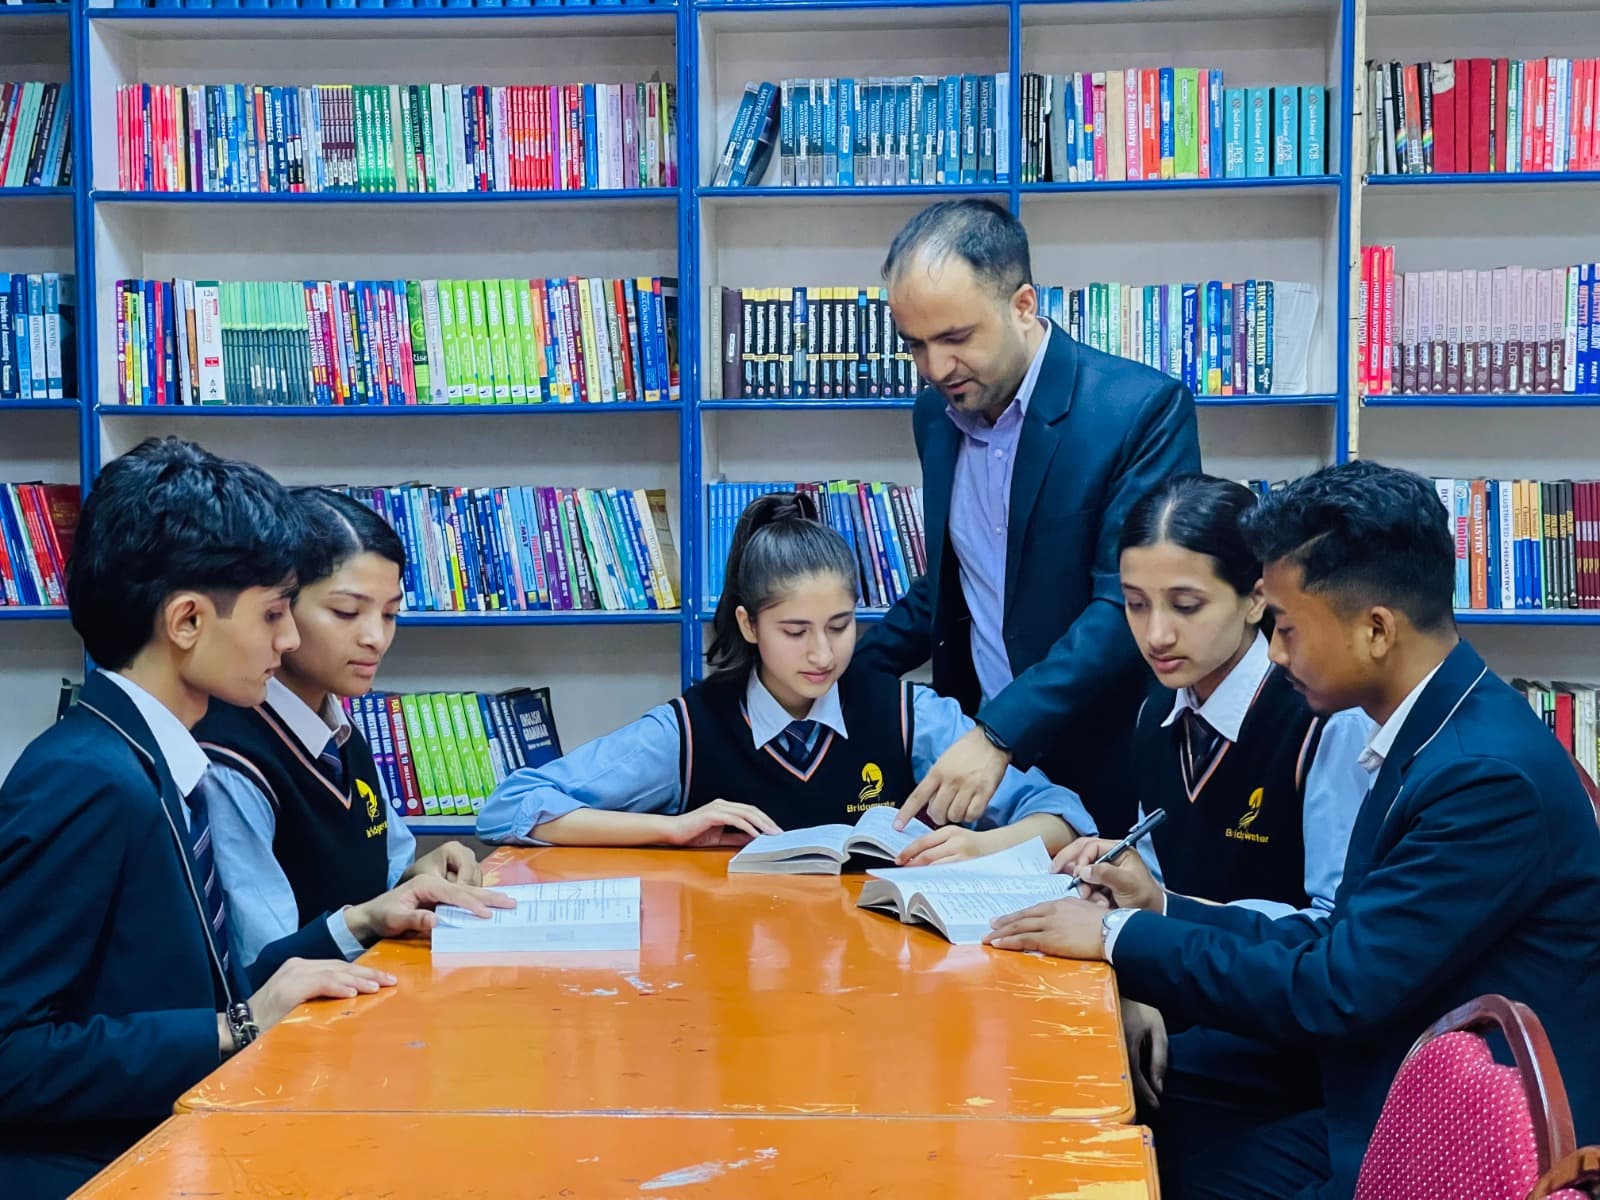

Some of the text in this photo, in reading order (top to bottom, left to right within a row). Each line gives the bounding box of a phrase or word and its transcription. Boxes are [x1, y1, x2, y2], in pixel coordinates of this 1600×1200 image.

[747, 88, 769, 139] MATHEMATICS
[1126, 100, 1137, 146] Chemistry
[1546, 92, 1556, 143] Chemistry
[1254, 146, 1265, 163] PCB
[1309, 143, 1320, 160] PCB
[342, 311, 352, 341] BUSINESS
[366, 310, 376, 341] BUSINESS
[388, 312, 399, 342] BUSINESS
[608, 301, 617, 320] Hotel
[641, 292, 650, 337] ACCOUNTING
[1256, 286, 1267, 365] BASIC MATHEMATICS
[1384, 282, 1392, 345] HUMAN ANATOMY
[1578, 284, 1589, 326] OBJECTIVE
[1, 330, 11, 361] Accounting
[33, 317, 41, 351] ACCOUNTING
[306, 310, 318, 367] BUSINESS STUDIES
[314, 310, 326, 367] BUSINESS STUDIES
[380, 310, 392, 366] BUSINESS STUDIES
[564, 308, 577, 364] BUSINESS STUDIES
[744, 304, 752, 353] Mathematics
[757, 306, 765, 354] Mathematics
[769, 304, 777, 353] Mathematics
[782, 306, 790, 354] Mathematics
[808, 304, 816, 353] Mathematics
[823, 304, 831, 353] Mathematics
[848, 304, 856, 353] Mathematics
[1372, 310, 1380, 345] ANATOMY
[1508, 324, 1518, 367] BIOLOGY
[1567, 332, 1576, 366] Zoology
[1578, 326, 1588, 353] ZOOLOGY
[1591, 324, 1600, 350] ZOOLOGY
[1263, 368, 1271, 389] Grade
[1502, 488, 1511, 538] ILLUSTRATED
[452, 515, 466, 571] BUSINESS STUDIES
[1456, 516, 1468, 560] Biology
[376, 712, 391, 739] QUESTION
[392, 713, 407, 741] QUESTION
[491, 701, 503, 726] ENGLISH
[500, 701, 513, 726] ENGLISH
